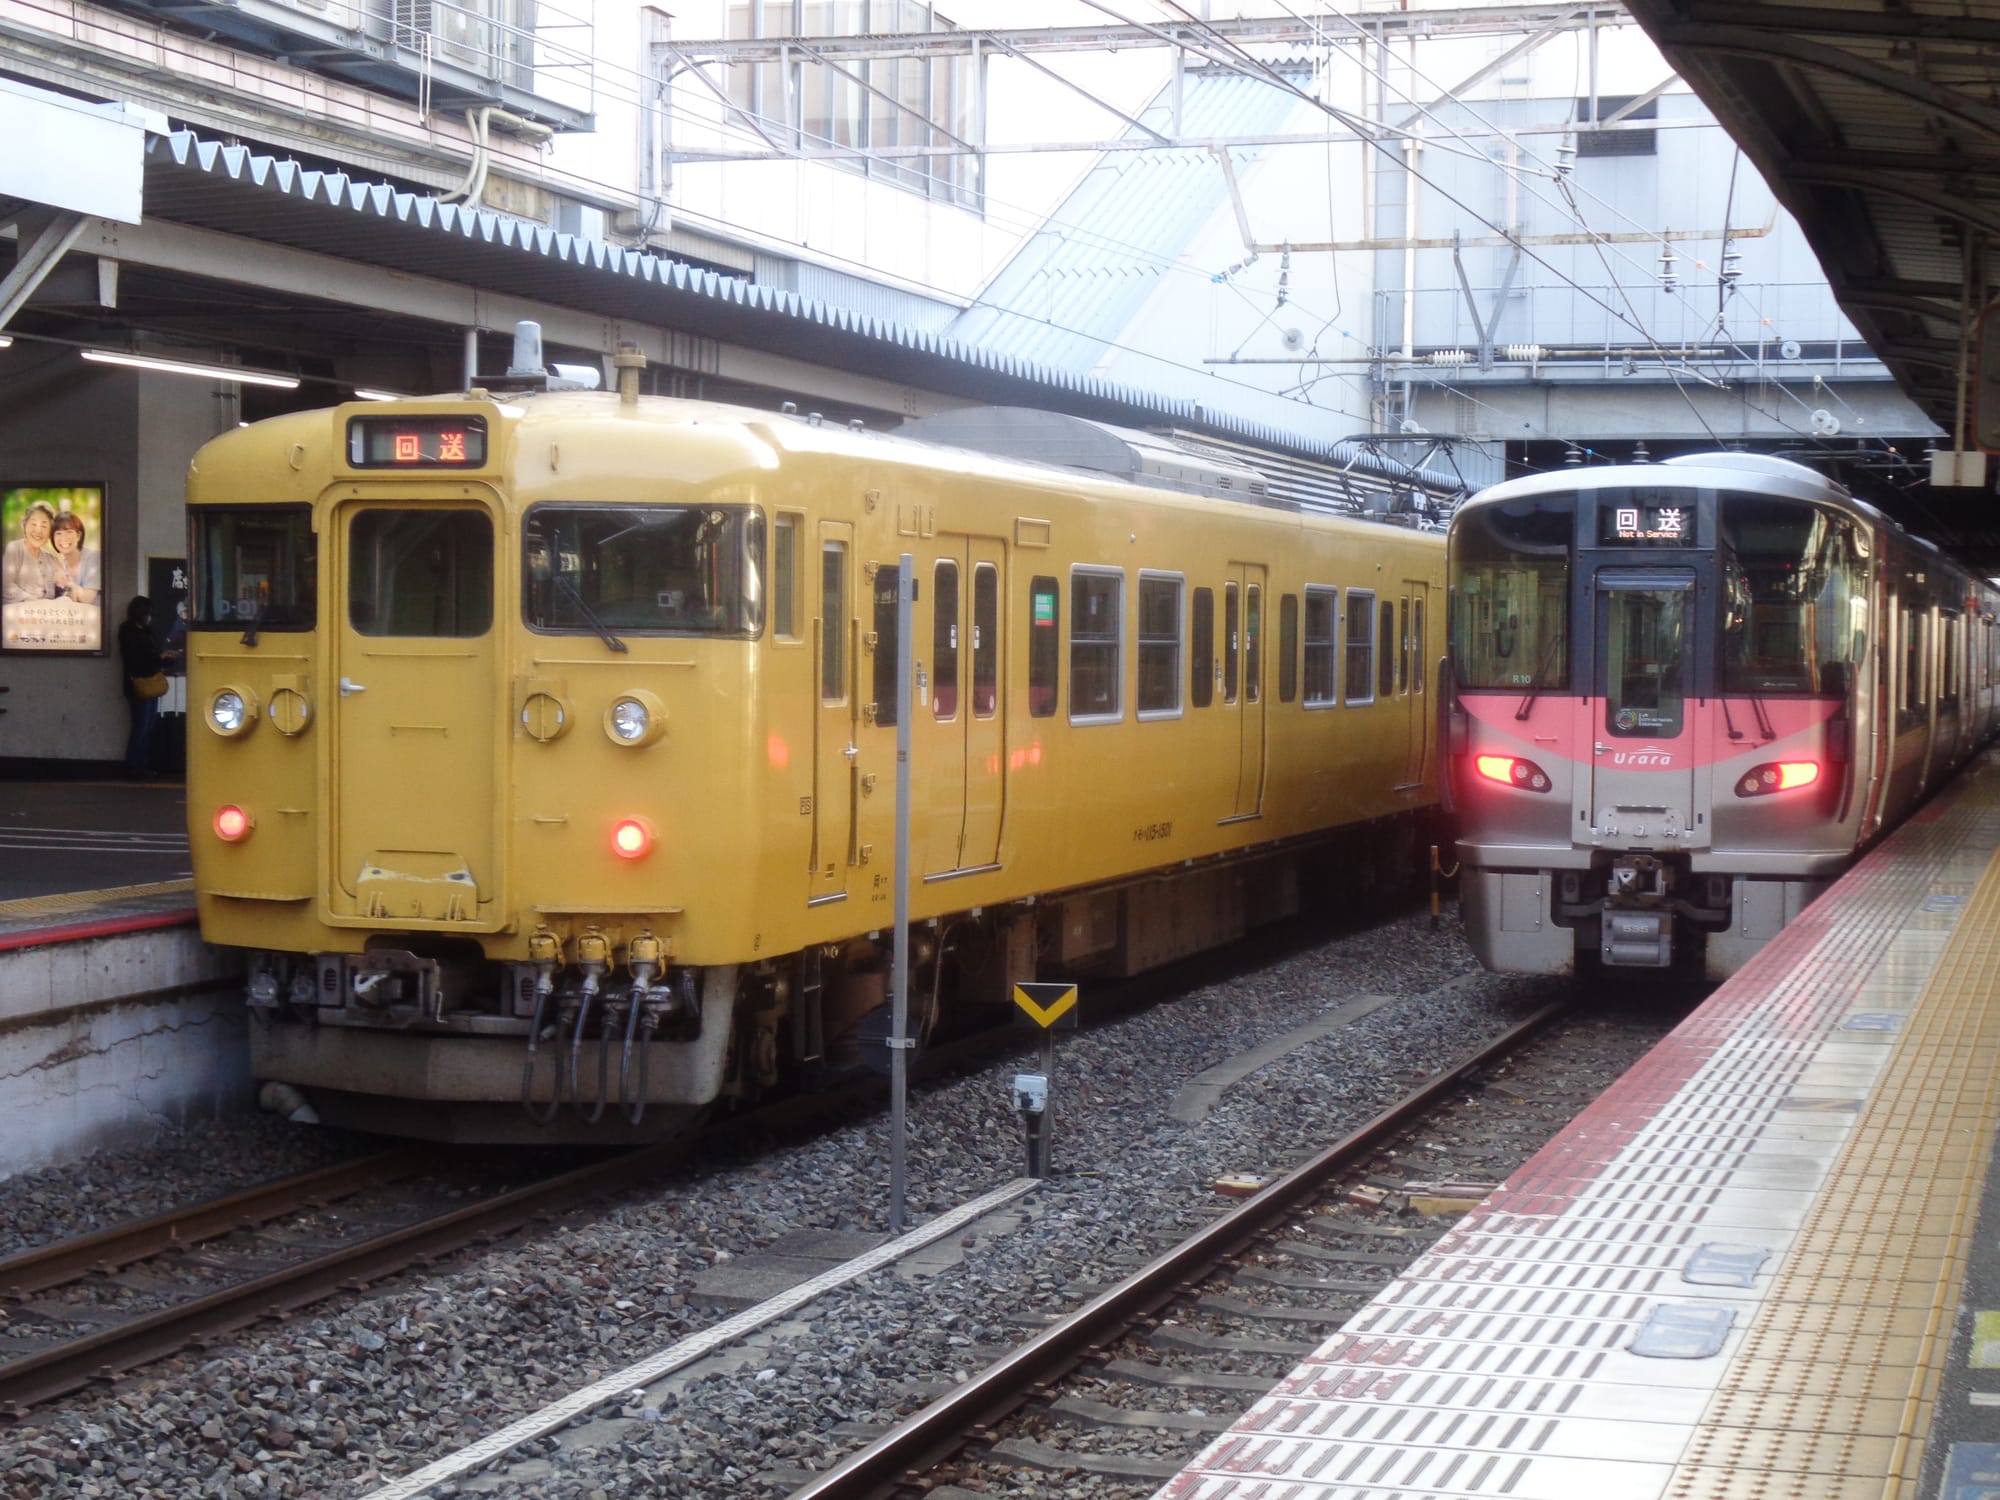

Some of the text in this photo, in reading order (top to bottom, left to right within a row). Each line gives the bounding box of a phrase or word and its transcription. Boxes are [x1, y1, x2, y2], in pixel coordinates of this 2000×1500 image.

[396, 433, 465, 460] 回送
[1616, 508, 1682, 531] 回送
[1619, 530, 1679, 538] Not in Service
[1512, 674, 1532, 684] R10
[1614, 752, 1672, 766] Urara
